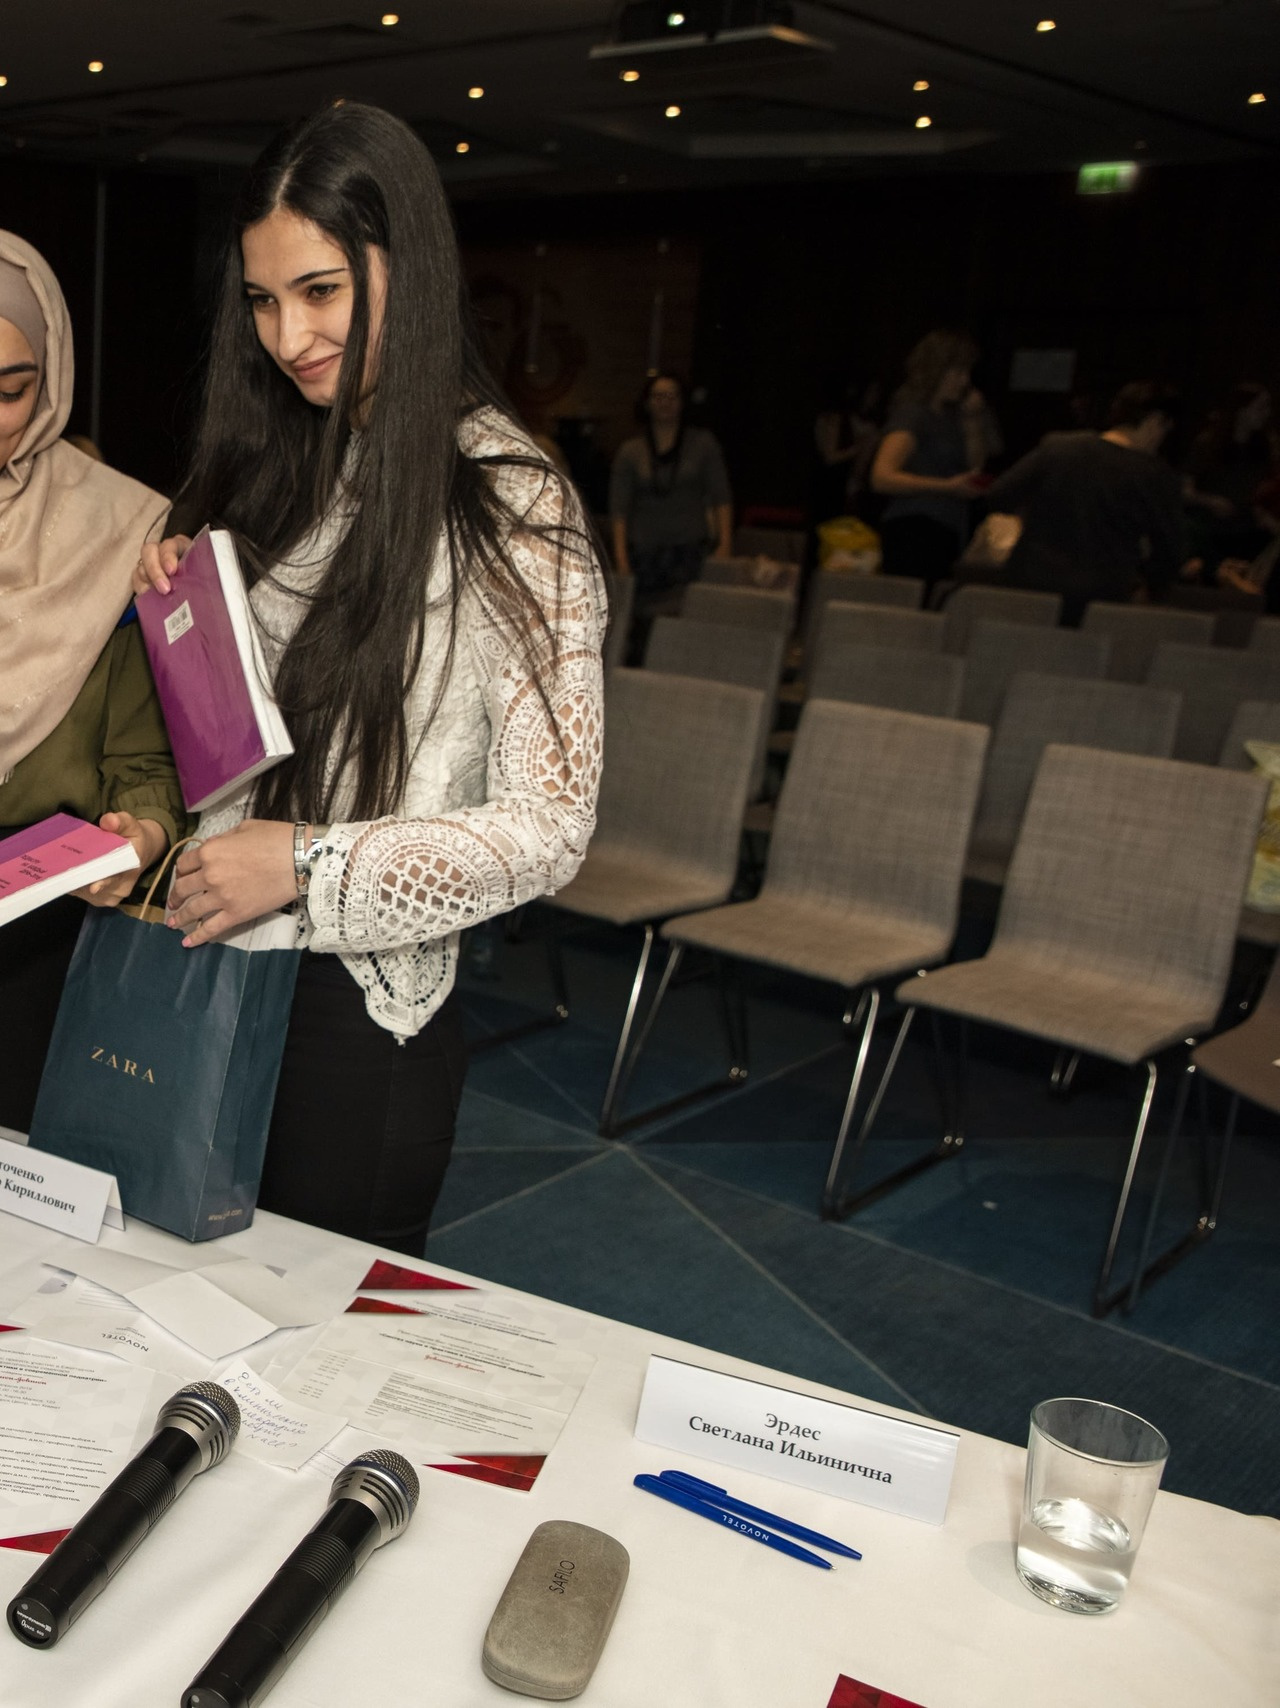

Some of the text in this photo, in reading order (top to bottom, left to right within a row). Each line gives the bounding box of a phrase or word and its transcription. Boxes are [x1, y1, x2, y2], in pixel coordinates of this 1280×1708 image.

[91, 1046, 155, 1084] ZARA
[4, 1179, 76, 1213] Кириллович
[101, 1333, 149, 1352] NOVOTEL
[764, 1413, 822, 1441] Эрдес
[689, 1416, 893, 1485] Светлана Ильинична
[722, 1514, 770, 1542] NOVOTEL
[549, 1560, 576, 1594] SAFILO
